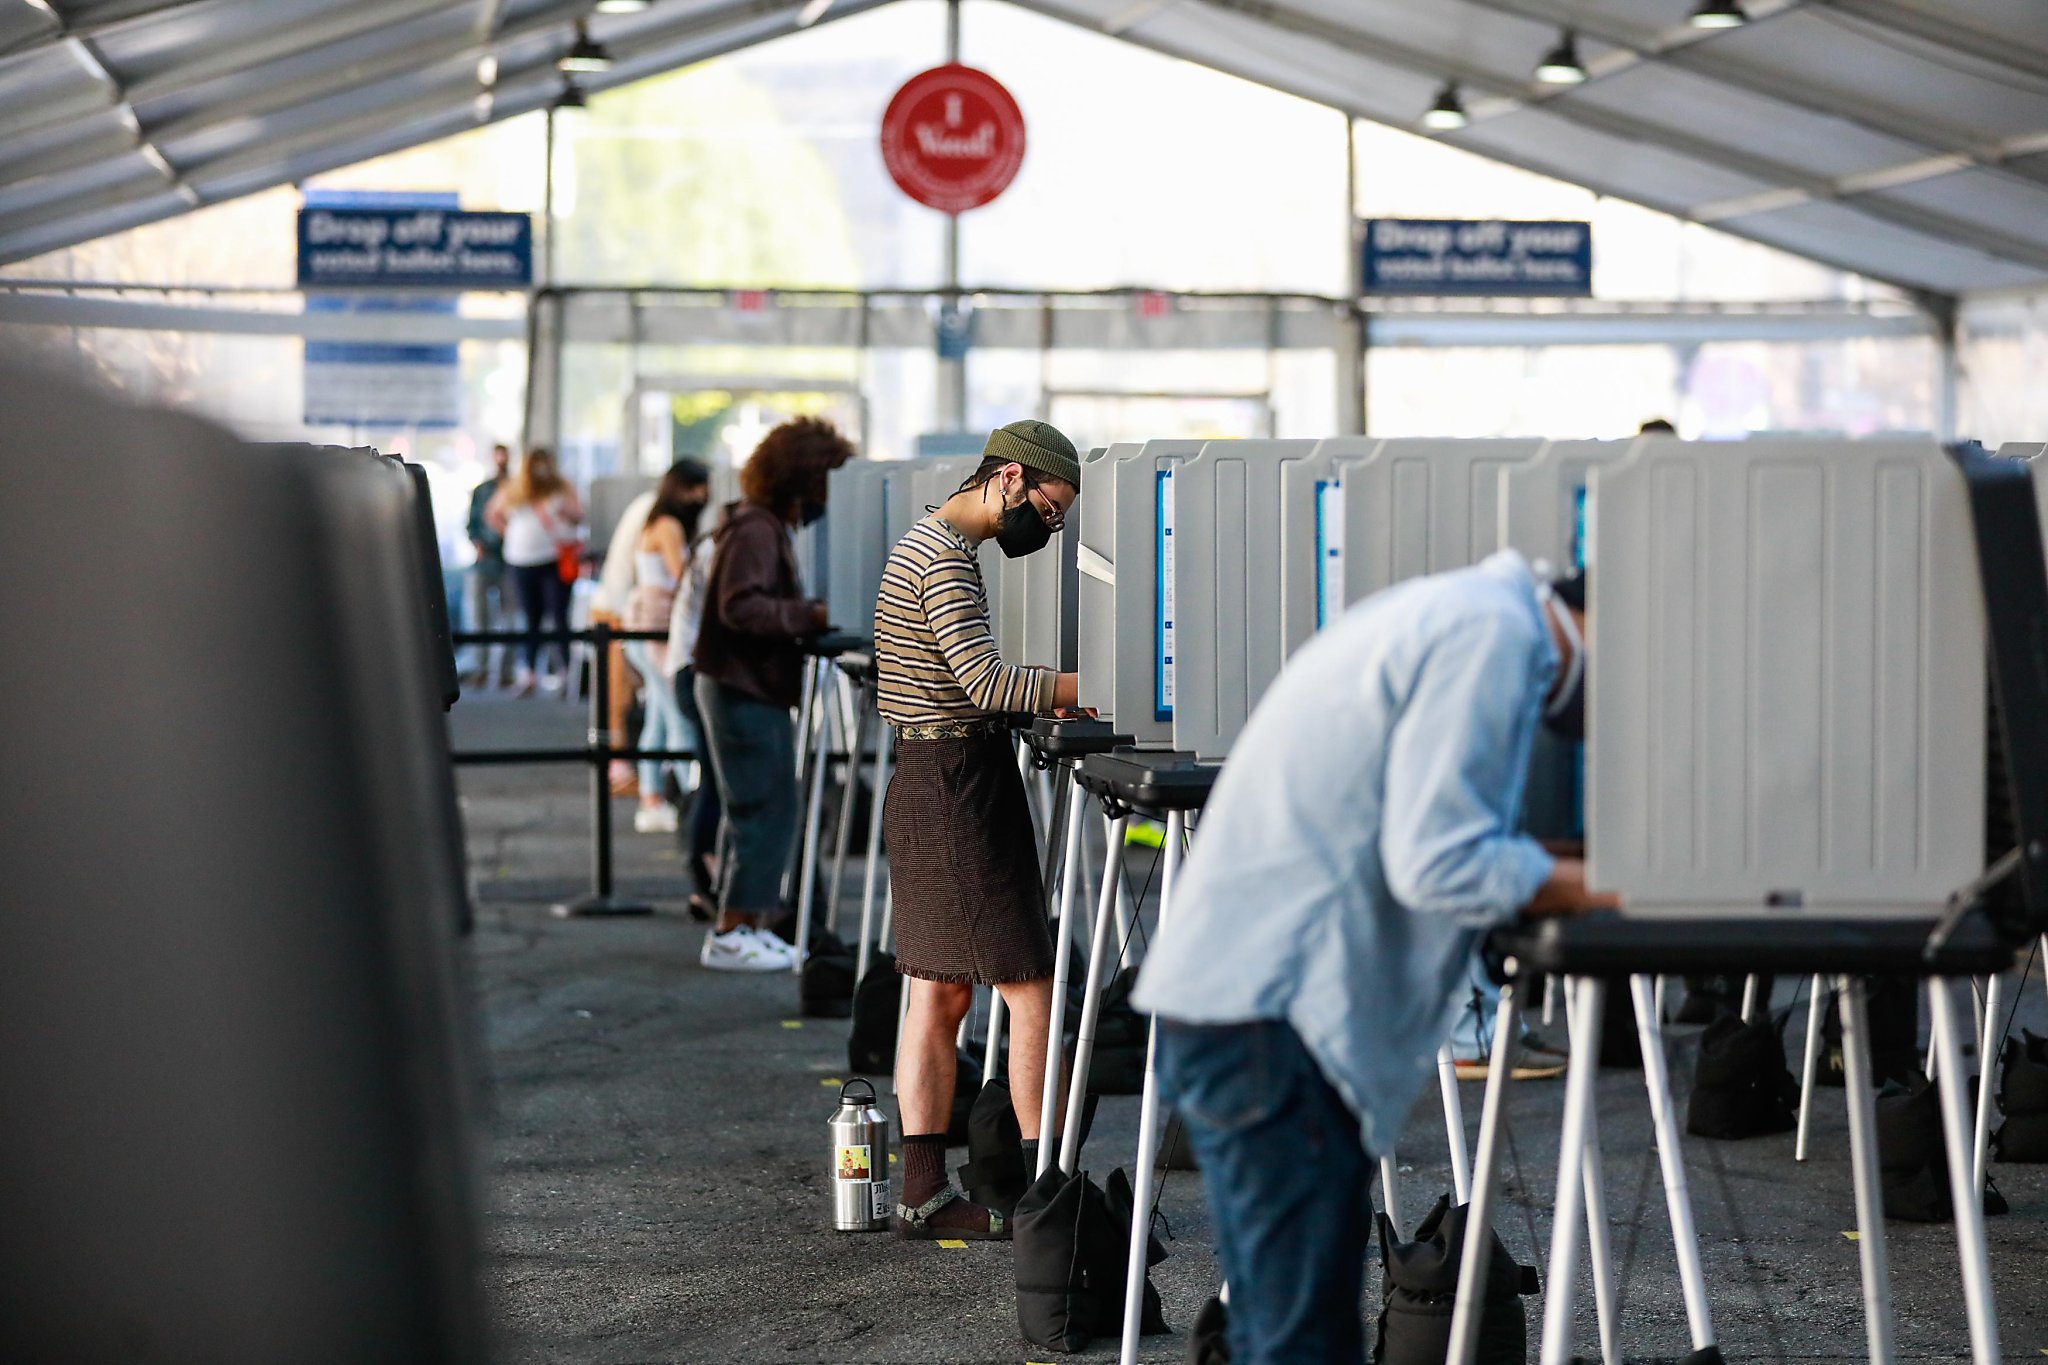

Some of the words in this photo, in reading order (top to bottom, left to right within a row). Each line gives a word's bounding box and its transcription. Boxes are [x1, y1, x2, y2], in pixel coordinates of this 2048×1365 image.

[308, 212, 388, 252] Drop
[393, 212, 443, 245] off
[448, 218, 521, 254] your
[1374, 221, 1451, 260] Drop
[1456, 221, 1506, 251] off
[1509, 228, 1581, 262] your
[311, 250, 379, 273] voted
[385, 248, 452, 273] ballot
[1377, 258, 1443, 281] voted
[1451, 256, 1517, 281] ballot
